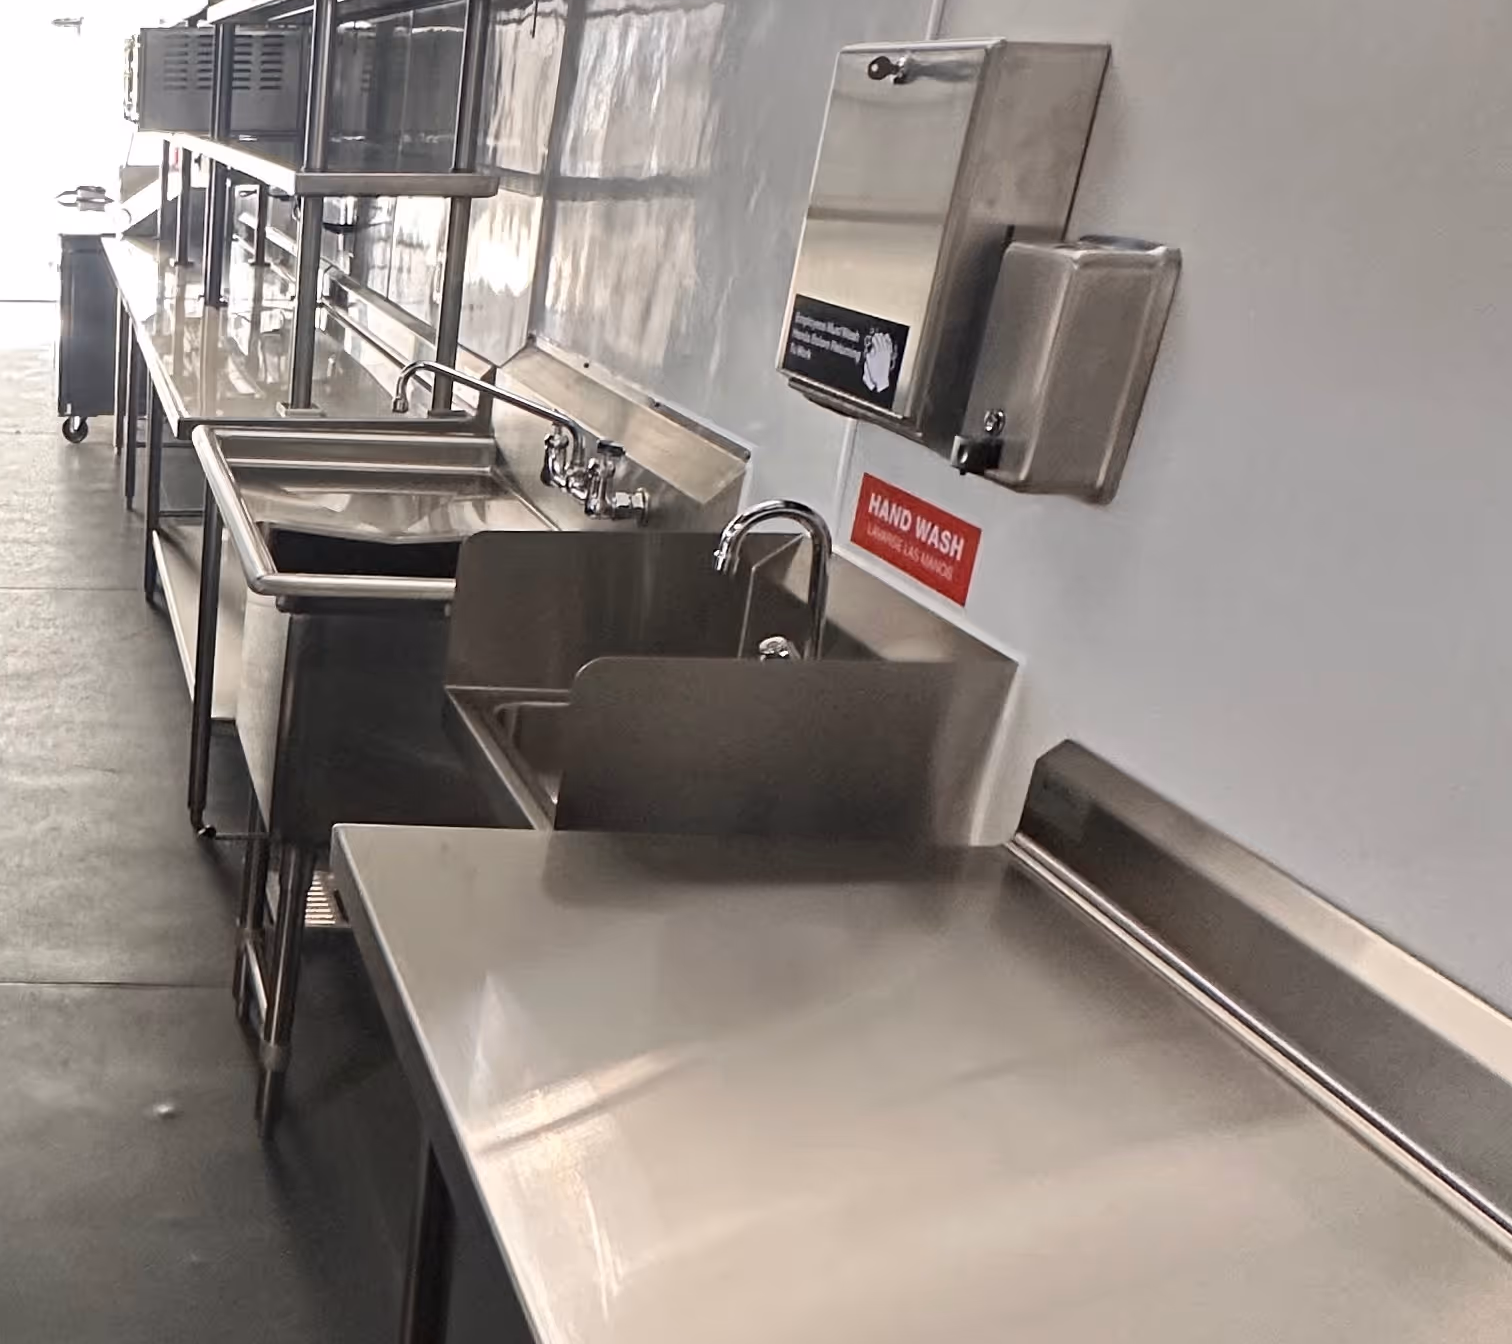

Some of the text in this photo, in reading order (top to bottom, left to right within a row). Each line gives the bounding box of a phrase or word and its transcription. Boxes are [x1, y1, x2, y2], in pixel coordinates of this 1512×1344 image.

[868, 493, 965, 561] HAND WASH
[903, 544, 920, 563] LAS
[921, 553, 954, 581] MANOS
